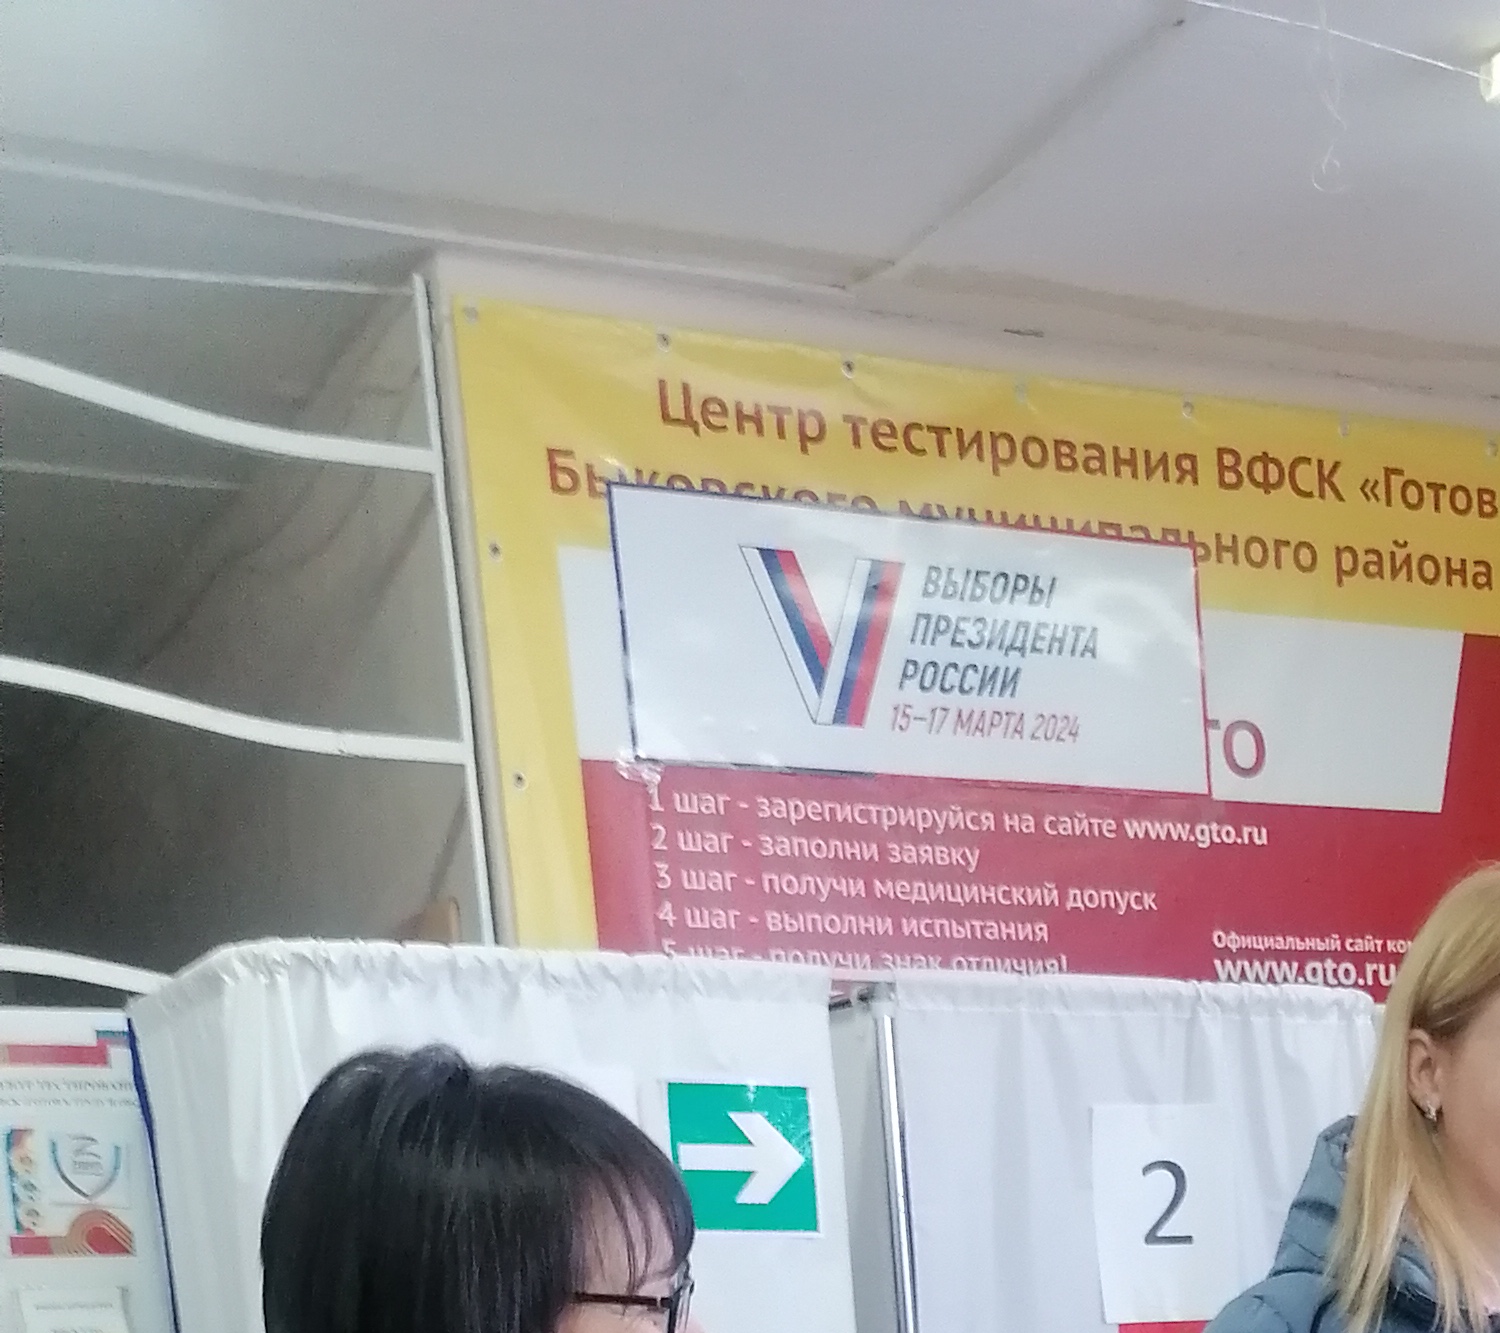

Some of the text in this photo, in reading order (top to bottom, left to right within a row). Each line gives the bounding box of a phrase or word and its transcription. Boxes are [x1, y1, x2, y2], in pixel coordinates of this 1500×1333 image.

[657, 378, 828, 456] Центр
[842, 413, 1199, 486] тестирования
[1216, 447, 1346, 502] ВФСК
[1359, 466, 1499, 520] «Готов
[922, 565, 1058, 608] ВЫБОРЫ
[1335, 539, 1493, 591] района
[910, 612, 1099, 659] ПРЕЗИДЕНТА
[898, 658, 1022, 698] РОССИИ
[953, 708, 1025, 740] МАРТА
[1030, 712, 1081, 744] 2024
[672, 791, 731, 815] шаг
[756, 795, 995, 834] зарегистрируйся
[1003, 812, 1035, 833] на
[1043, 812, 1117, 839] сайте
[1123, 816, 1268, 848] www.gto.ru
[651, 822, 668, 850] 2
[677, 829, 734, 854] шаг
[758, 833, 880, 862] заполни
[887, 841, 980, 873] заявку
[655, 861, 671, 889] 3
[681, 869, 738, 892] шаг
[761, 871, 866, 902] получи
[873, 879, 1059, 908] медицинский
[1066, 886, 1158, 915] допуск
[657, 900, 677, 928] 4
[683, 906, 741, 930] шаг
[765, 910, 893, 936] выполни
[901, 917, 1049, 943] испытания
[1212, 930, 1341, 952] Официальный
[1345, 934, 1382, 953] сайт
[1142, 1160, 1194, 1246] 2
